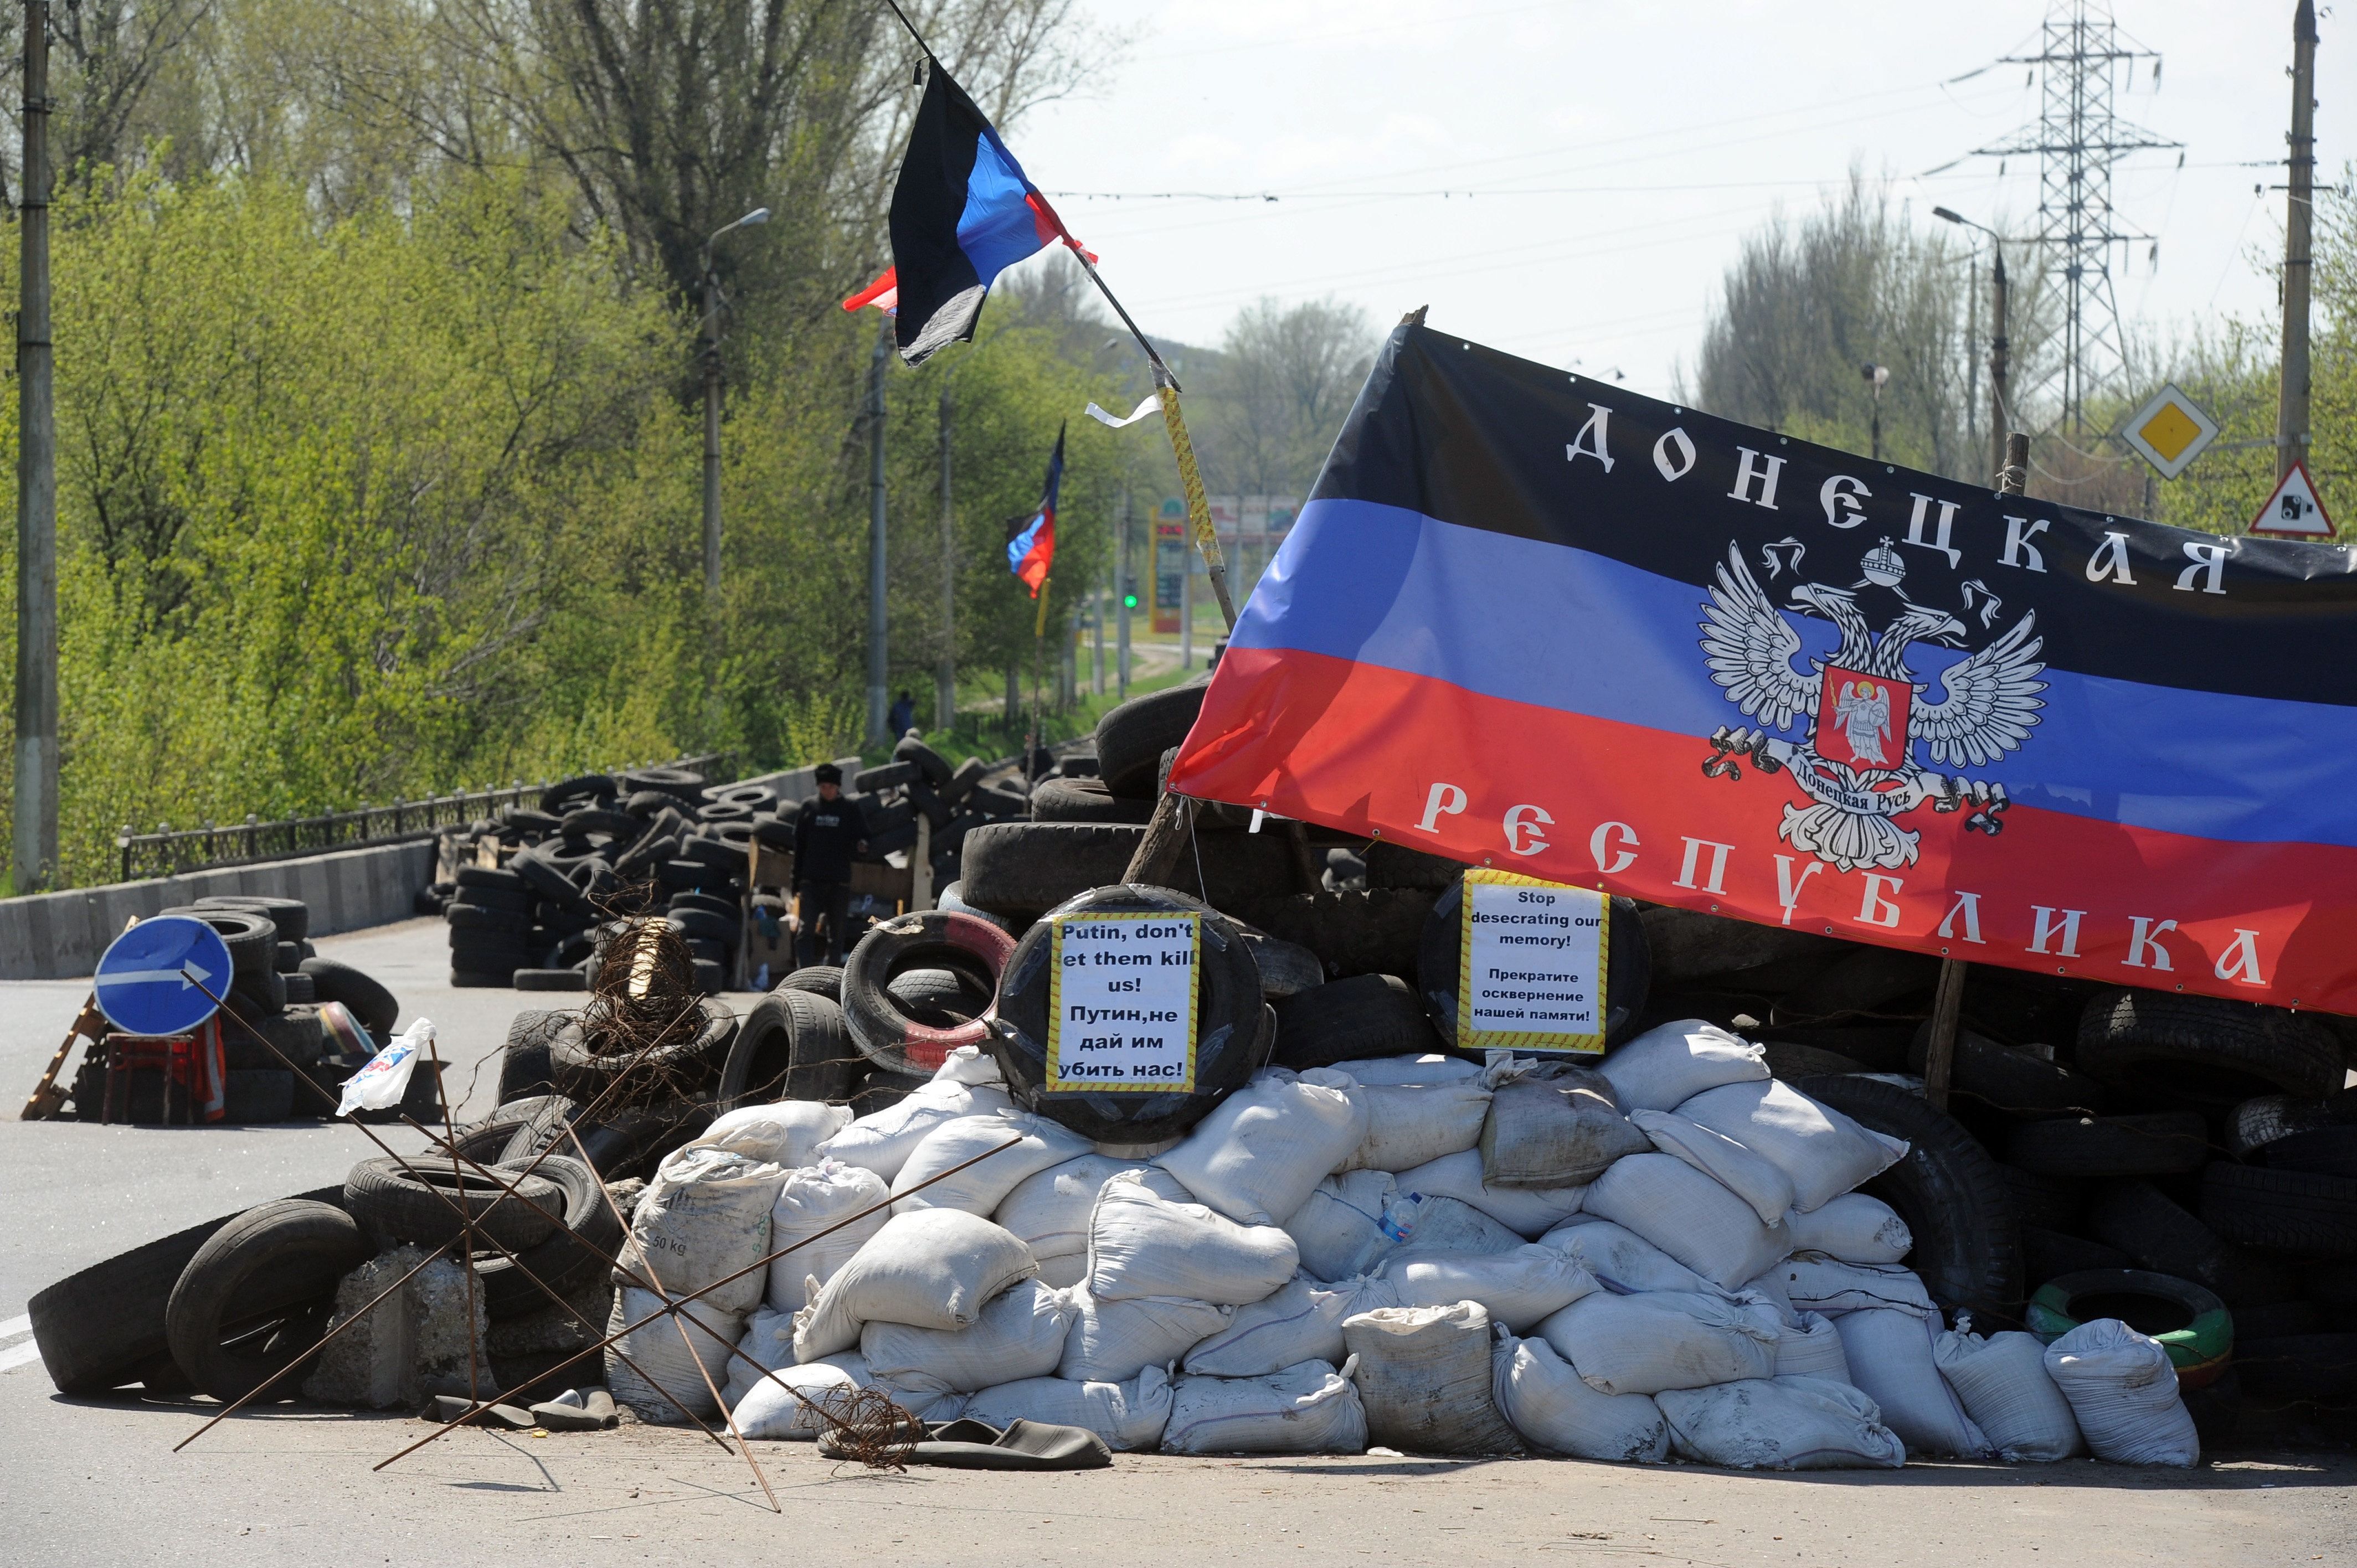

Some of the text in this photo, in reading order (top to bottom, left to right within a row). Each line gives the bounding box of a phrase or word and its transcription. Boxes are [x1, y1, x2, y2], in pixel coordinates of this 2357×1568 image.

[1797, 760, 1911, 815] Донецкая Русь
[1517, 891, 1556, 906] Stop
[1471, 912, 1602, 928] desecrating our
[1062, 924, 1193, 942] Putin, don't
[1500, 935, 1571, 949] memory!
[1057, 951, 1195, 967] et them kill
[1489, 968, 1579, 983] Прекратите
[1108, 978, 1141, 992] us!
[1481, 989, 1584, 1002] осквернение
[1070, 1005, 1179, 1024] Путин,не
[1474, 1008, 1590, 1022] нашей памяти!
[1079, 1033, 1163, 1051] дай им
[1058, 1062, 1182, 1079] убить нас!
[653, 1235, 687, 1256] 50 kg
